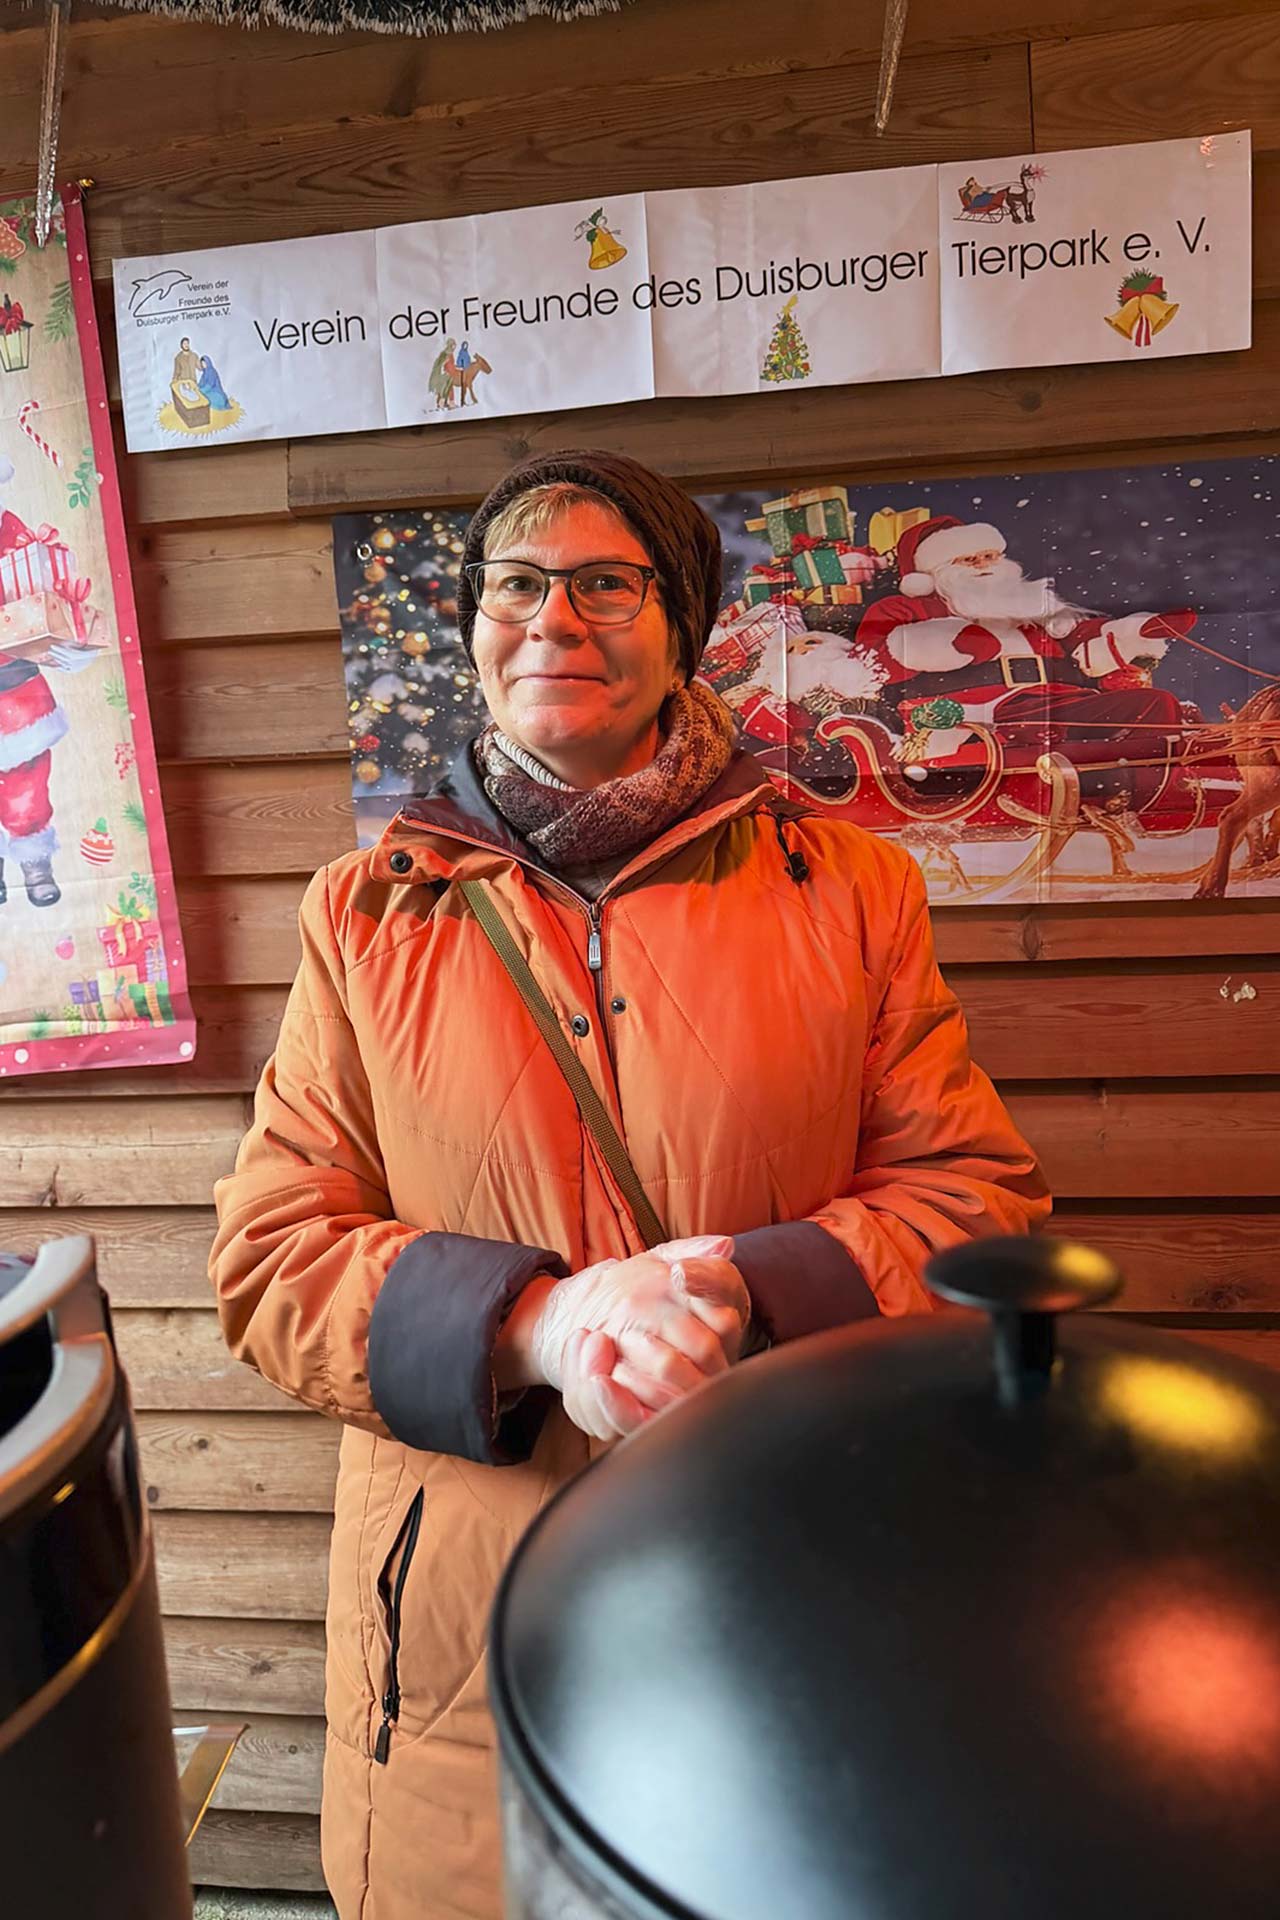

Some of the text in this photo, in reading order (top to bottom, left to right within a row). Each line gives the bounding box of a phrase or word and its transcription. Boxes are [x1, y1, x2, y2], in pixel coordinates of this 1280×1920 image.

[187, 280, 229, 292] Verein der
[253, 216, 1210, 351] Verein der Freunde des Duisburger Tierpark e. V.
[178, 294, 229, 307] Freunde des
[136, 306, 231, 327] Duisburger Tierpark e.V.
